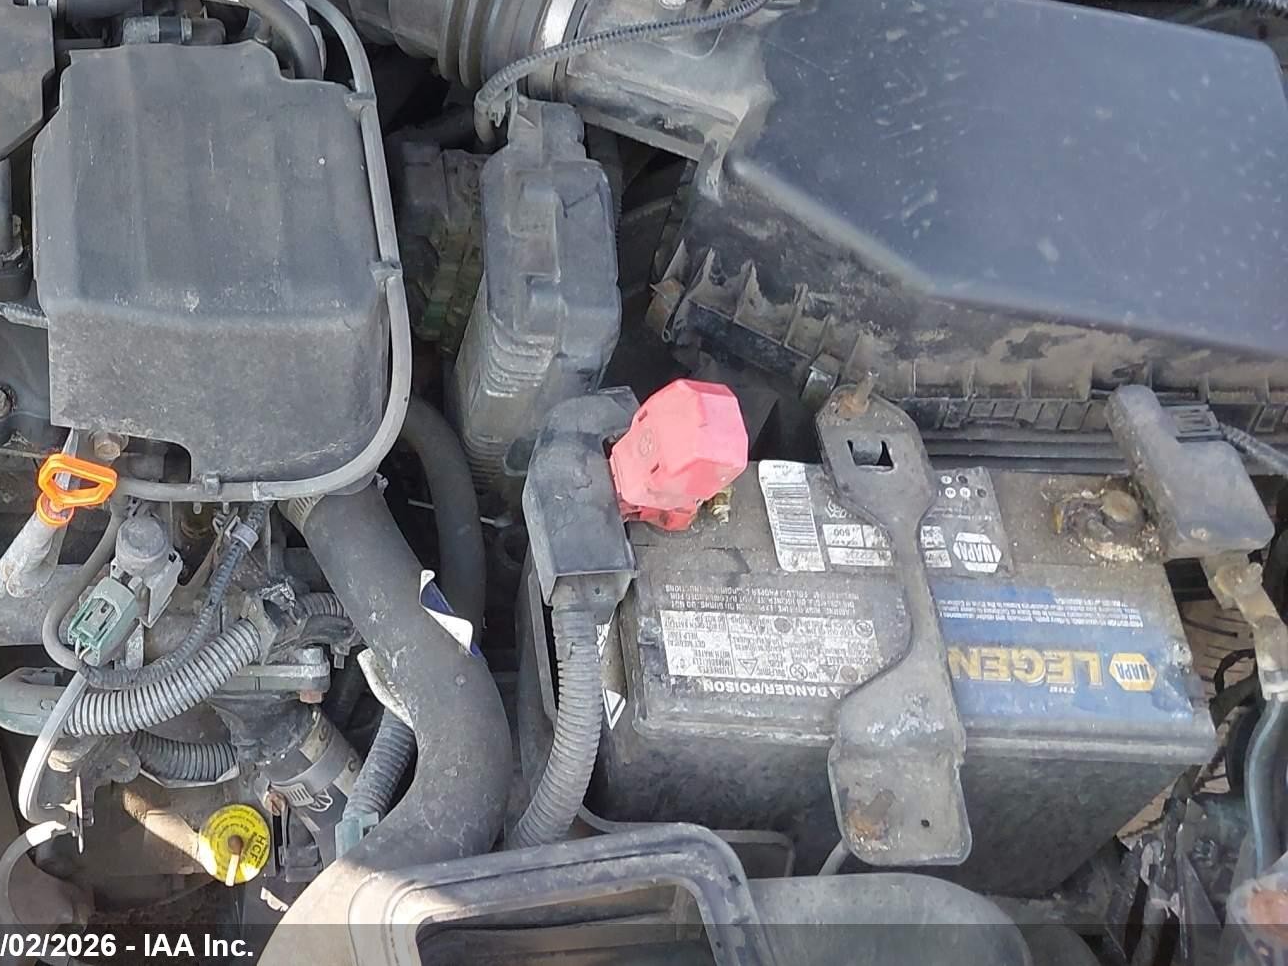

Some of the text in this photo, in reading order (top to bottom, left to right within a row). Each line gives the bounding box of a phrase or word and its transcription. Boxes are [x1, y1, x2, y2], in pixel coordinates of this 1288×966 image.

[958, 542, 994, 562] NAPA
[1115, 663, 1149, 682] NAPA
[703, 680, 829, 698] DANGER/POISON
[1049, 686, 1075, 694] THE
